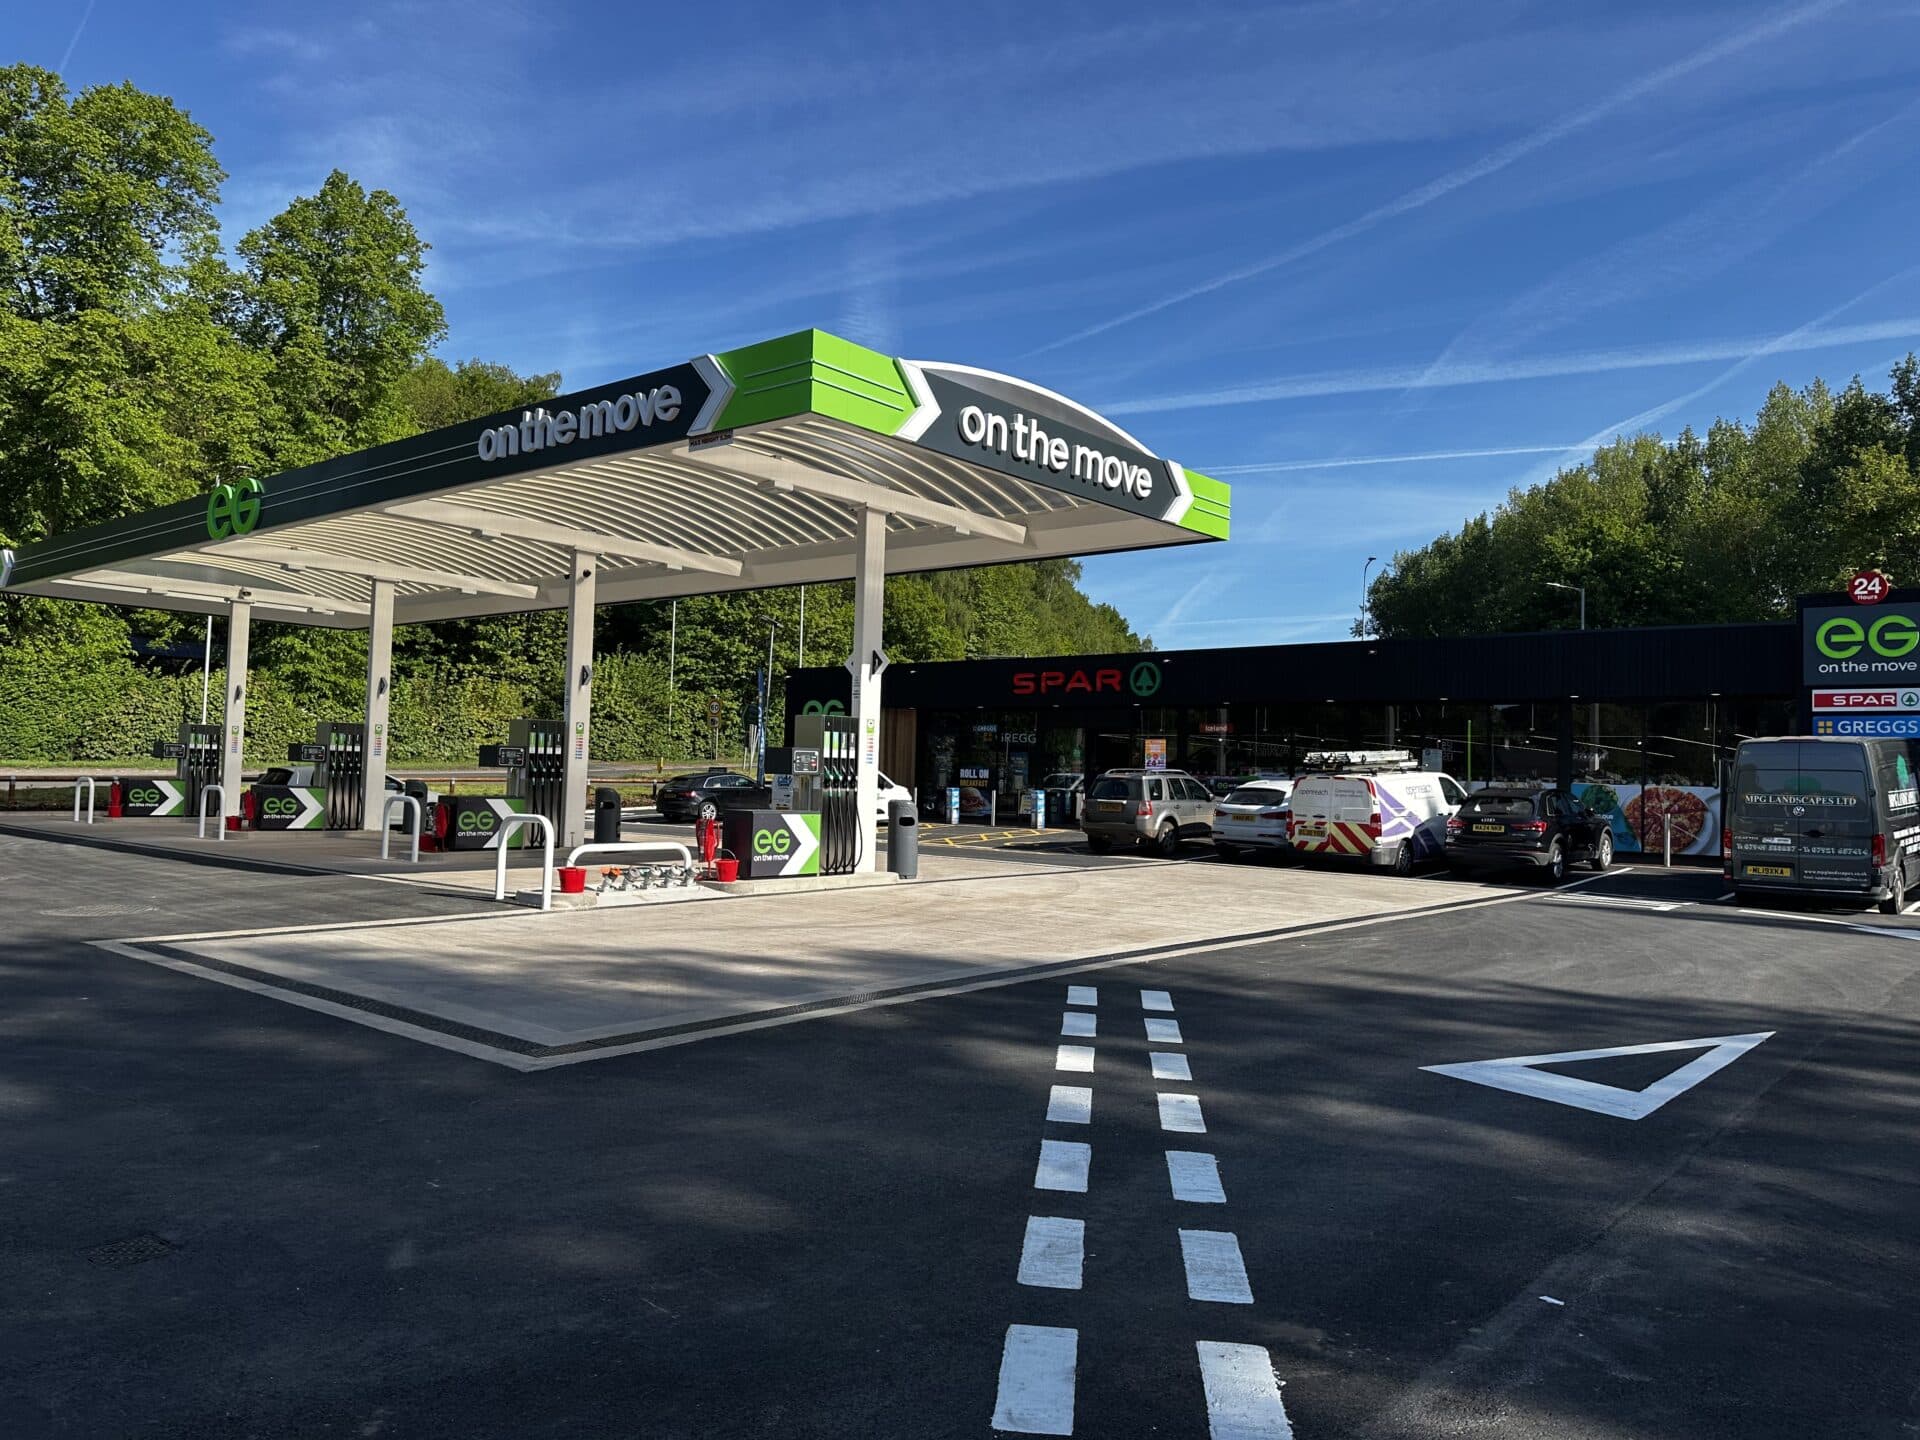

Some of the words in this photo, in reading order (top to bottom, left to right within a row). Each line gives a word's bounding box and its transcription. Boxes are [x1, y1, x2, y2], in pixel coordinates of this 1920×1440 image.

[478, 424, 519, 462] on
[520, 407, 578, 452] the
[579, 384, 682, 439] move
[959, 405, 1008, 453] on
[1010, 413, 1069, 471] the
[1071, 444, 1153, 499] move
[1854, 577, 1882, 595] 24
[1818, 663, 1839, 673] on
[1842, 661, 1869, 672] the
[1872, 661, 1918, 672] move
[1013, 669, 1122, 695] SPAR
[1833, 694, 1896, 706] SPAR
[710, 704, 719, 712] 60
[1205, 724, 1228, 732] Iceland
[1838, 720, 1918, 734] GREGGS
[960, 768, 977, 779] ROLL
[979, 769, 989, 779] ON
[1745, 794, 1767, 804] MPG
[1770, 795, 1835, 805] LANDSCAPES
[1837, 796, 1857, 806] LTD
